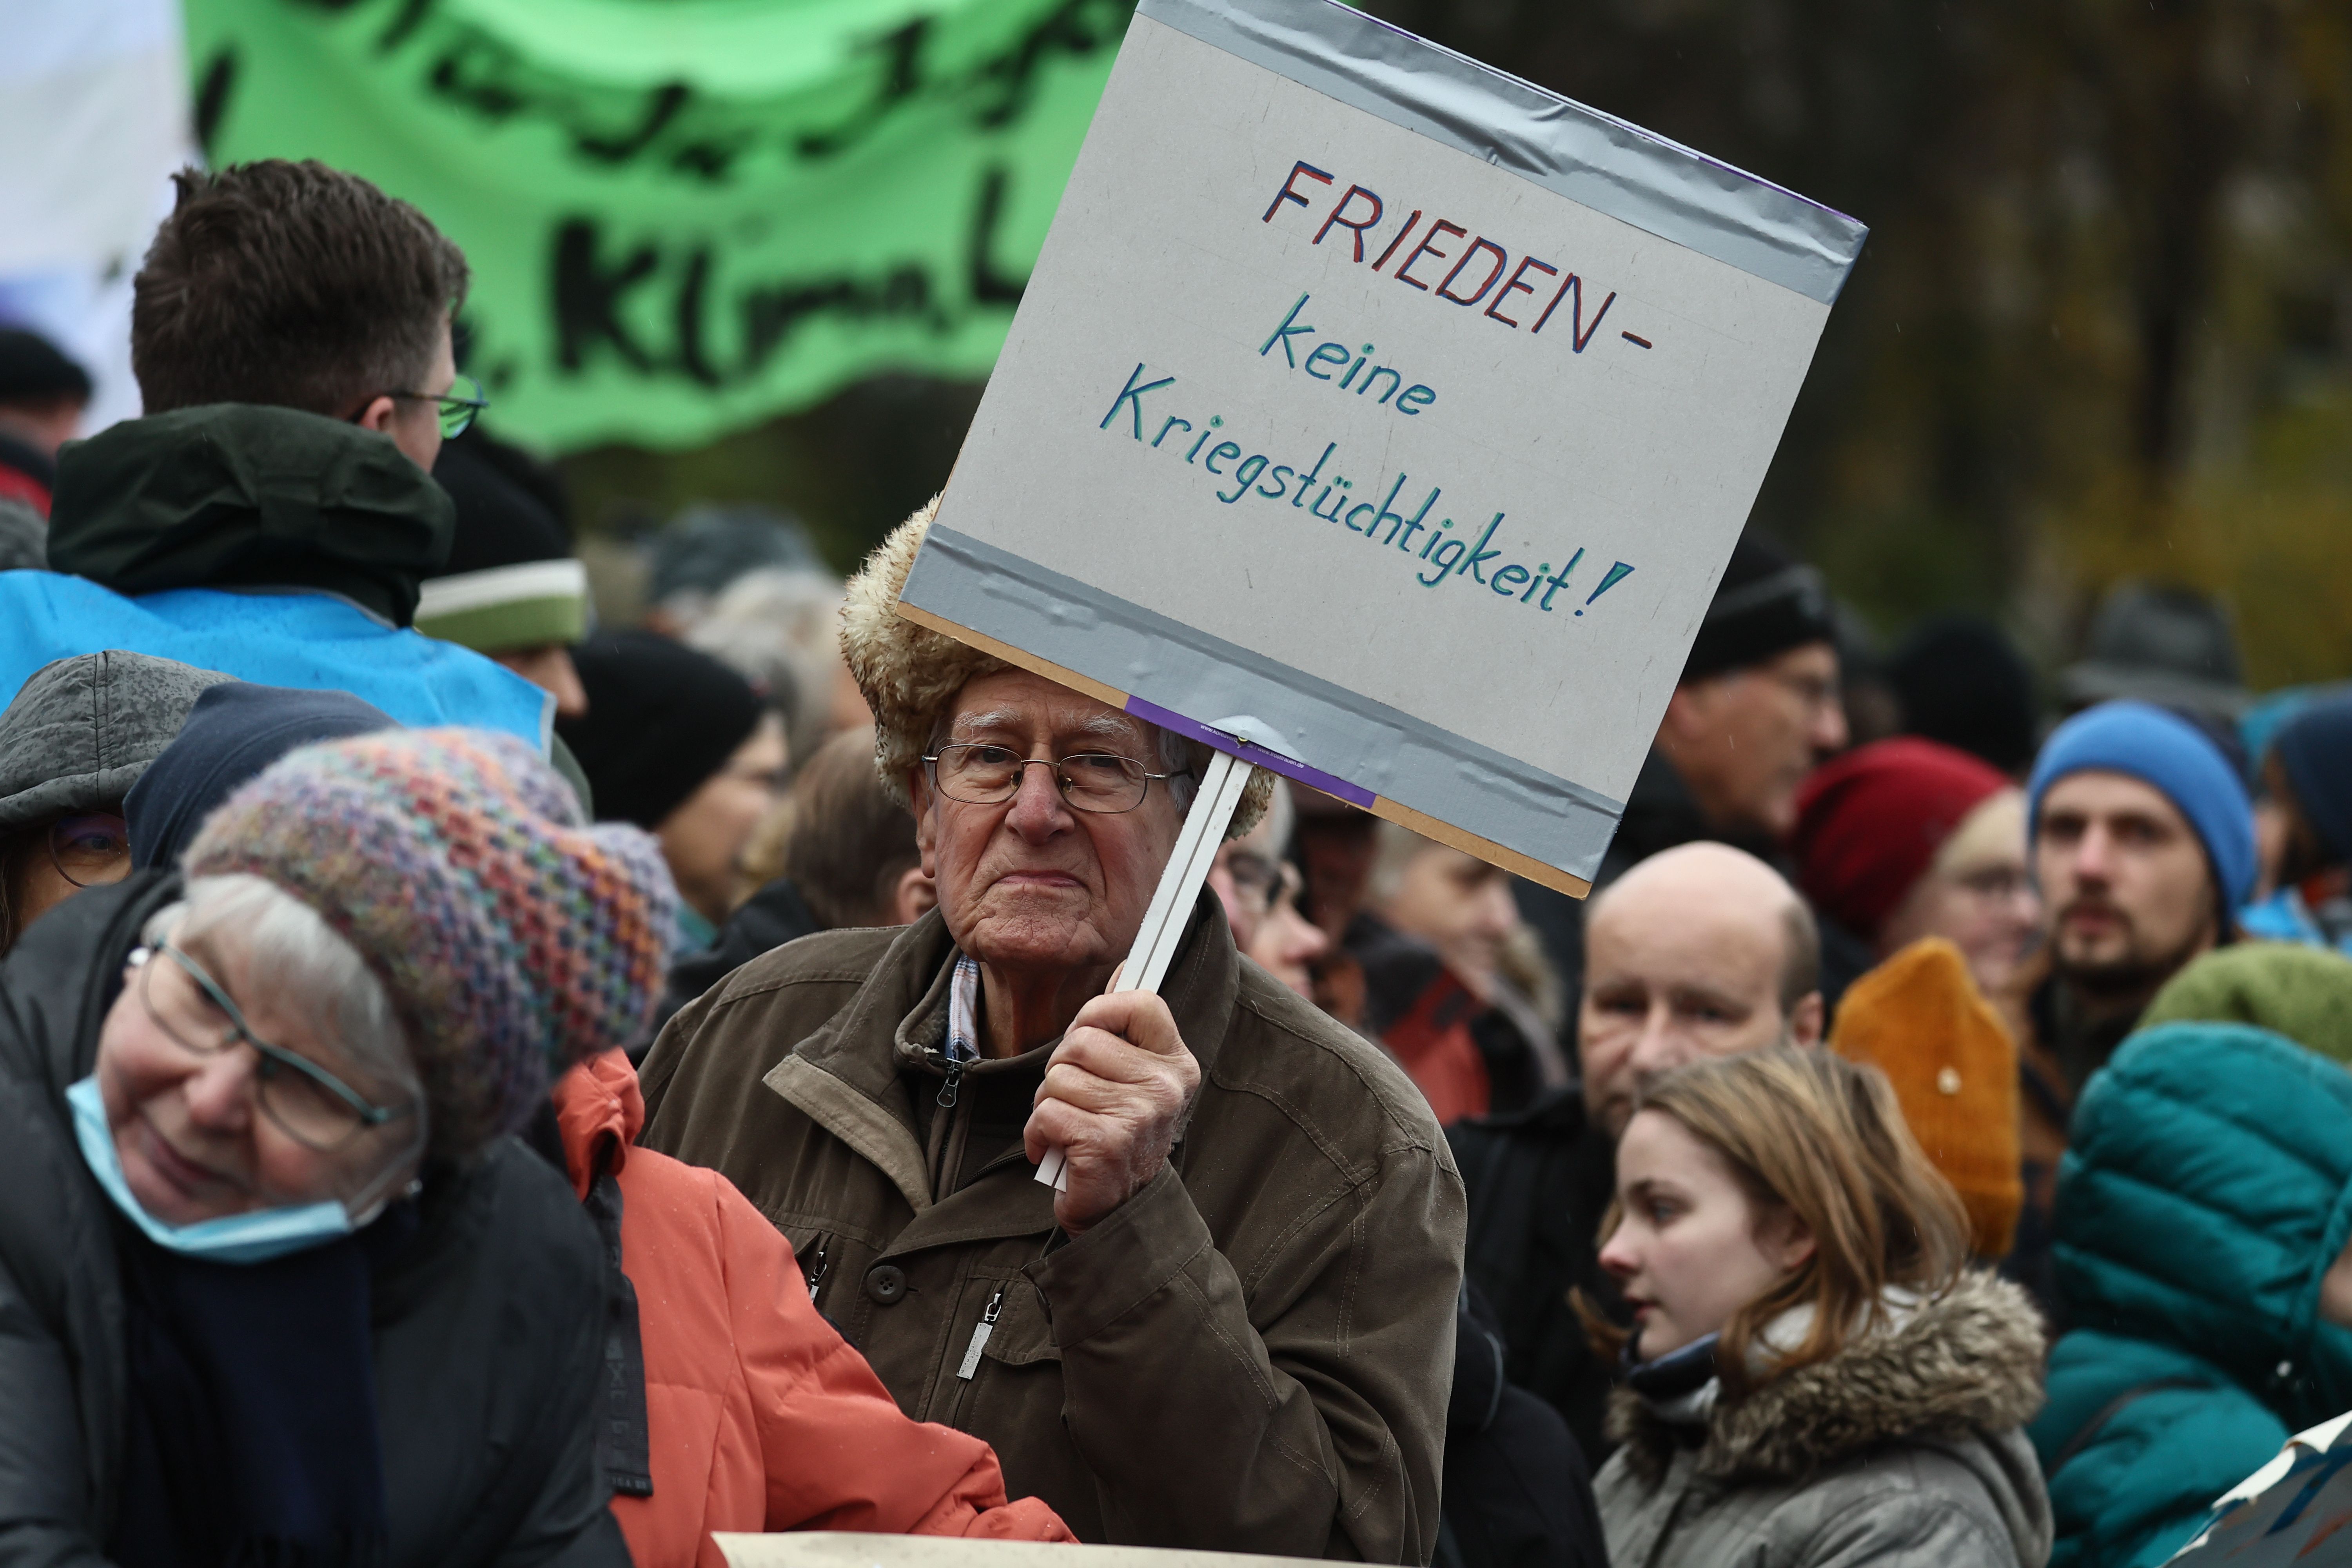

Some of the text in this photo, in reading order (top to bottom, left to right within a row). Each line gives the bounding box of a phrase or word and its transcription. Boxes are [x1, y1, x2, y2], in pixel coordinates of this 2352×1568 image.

[1262, 160, 1652, 353] FRIEDEN-
[1259, 292, 1437, 416] keine
[1100, 362, 1634, 616] Kriegstüchtigkeit!
